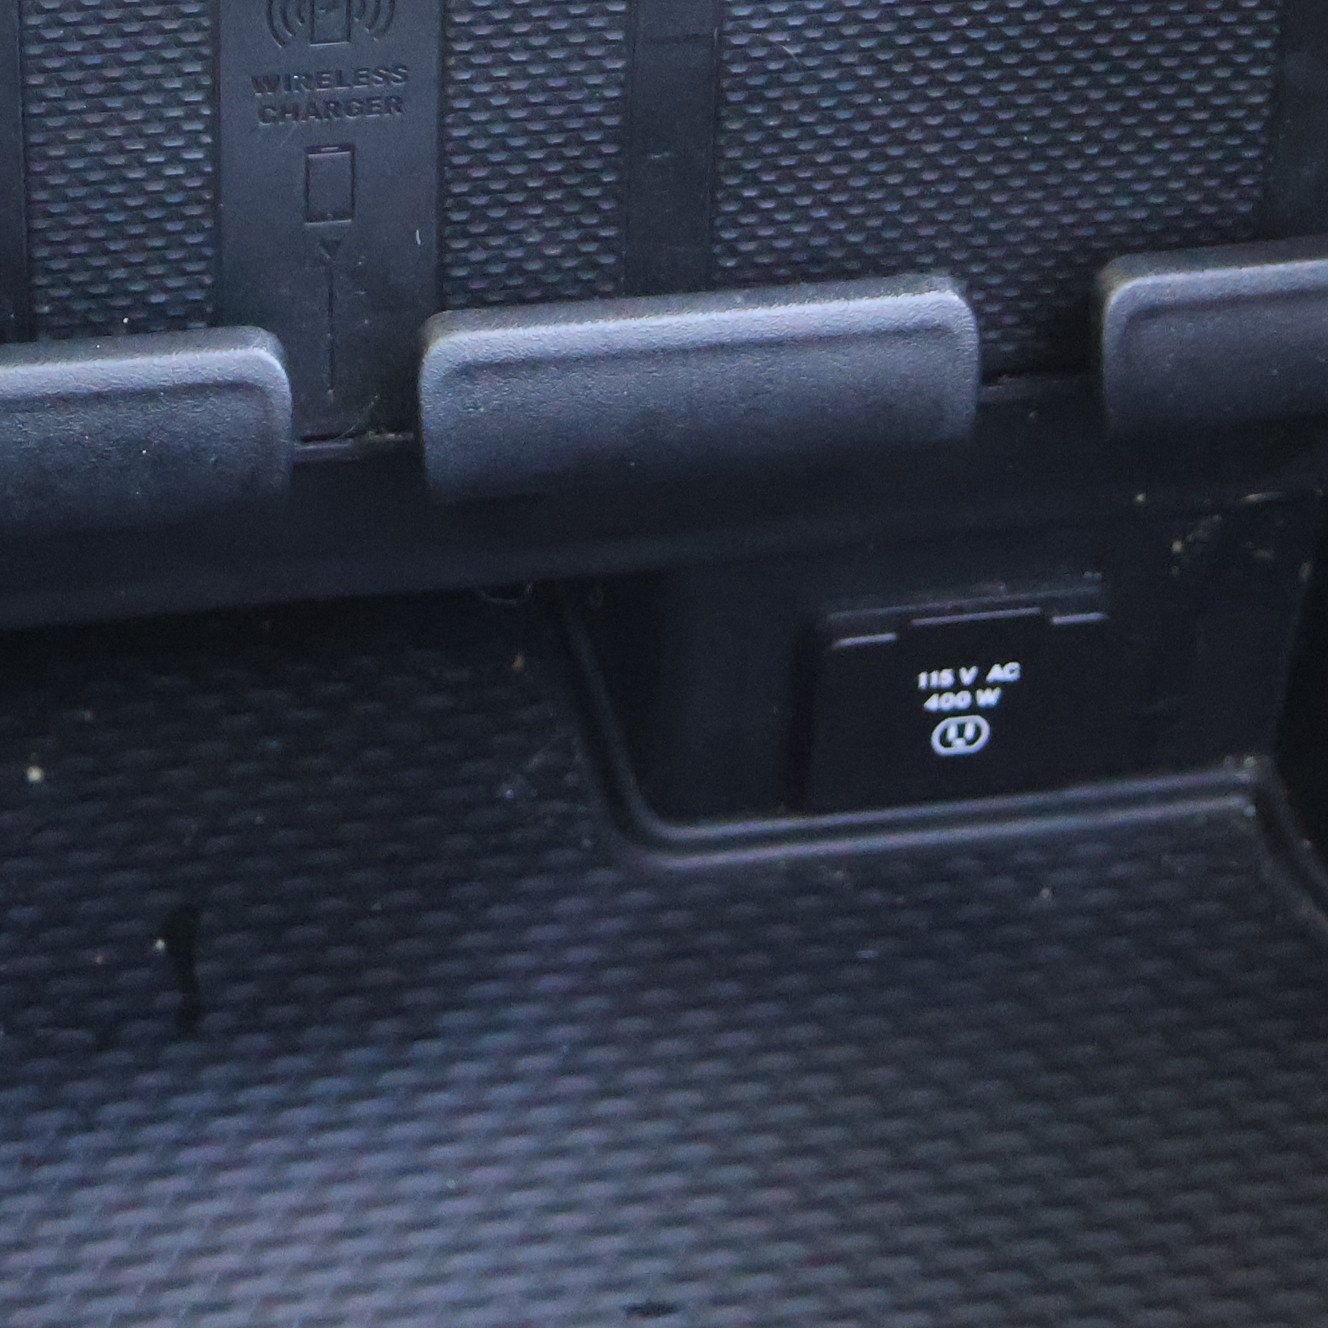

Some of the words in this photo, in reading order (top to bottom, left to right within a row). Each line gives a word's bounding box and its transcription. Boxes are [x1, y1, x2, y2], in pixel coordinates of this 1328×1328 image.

[250, 65, 409, 96] WIRELESS
[257, 95, 405, 125] CHARGER
[918, 668, 955, 690] 115
[959, 666, 979, 686] V
[986, 661, 1022, 683] AC
[923, 690, 972, 712] 400
[976, 687, 1002, 708] W
